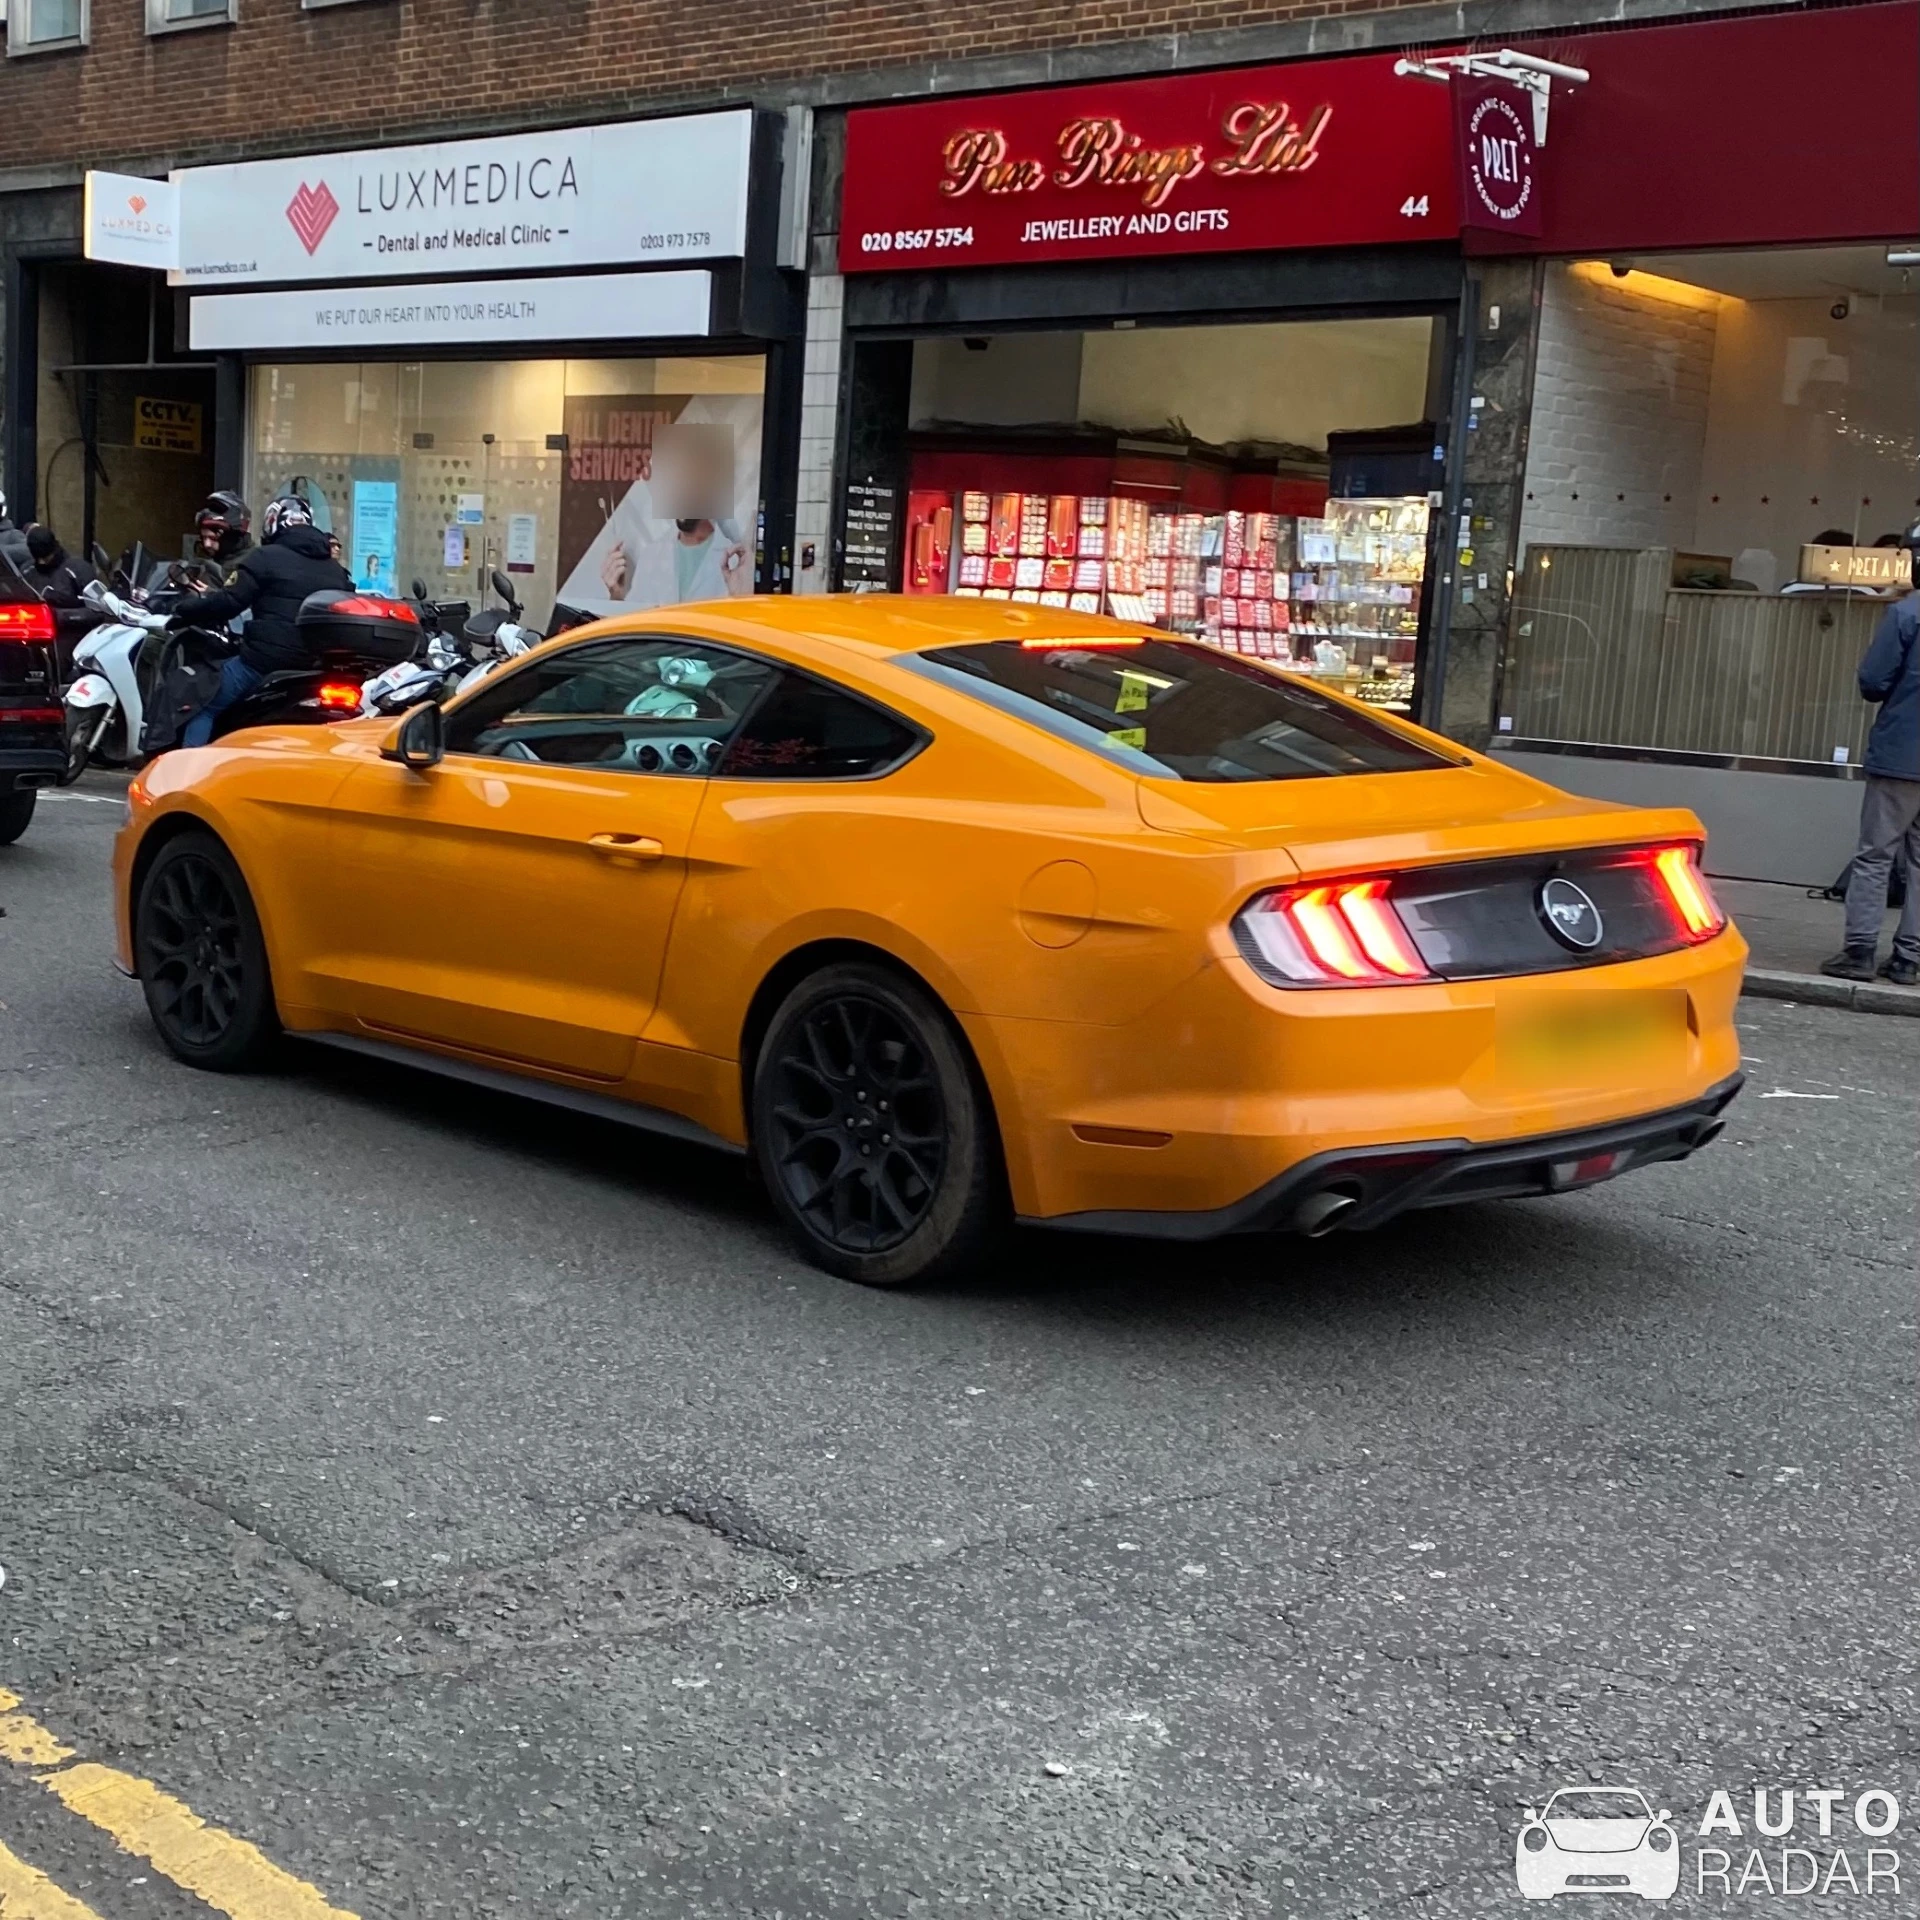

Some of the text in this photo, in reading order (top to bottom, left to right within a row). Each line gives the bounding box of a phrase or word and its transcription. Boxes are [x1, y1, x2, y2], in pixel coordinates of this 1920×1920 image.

[1470, 97, 1526, 143] ORGANIC COFFEE
[1053, 117, 1205, 208] Rings
[1210, 102, 1333, 176] Ltd
[1482, 134, 1518, 183] PRET
[358, 156, 578, 213] LUXMEDICA
[1471, 165, 1532, 219] FRESHLY MADE FOOD
[1400, 195, 1430, 217] 44
[101, 216, 172, 236] LUXMEDCA
[378, 225, 552, 253] Dental and Medical Clinic
[861, 226, 974, 252] 020 8567 5754
[1020, 208, 1229, 242] JEWELLERY AND GIFTS
[640, 232, 710, 250] 0203 973 7578
[185, 260, 258, 274] www.luxmedica.co.uk
[316, 301, 536, 325] WE PUT OUR HEART INTO YOUR HEALTH
[141, 400, 192, 422] CCTV
[571, 410, 602, 445] ALL
[570, 448, 652, 481] SERVICES
[1847, 557, 1880, 576] PRET
[1881, 559, 1890, 577] A
